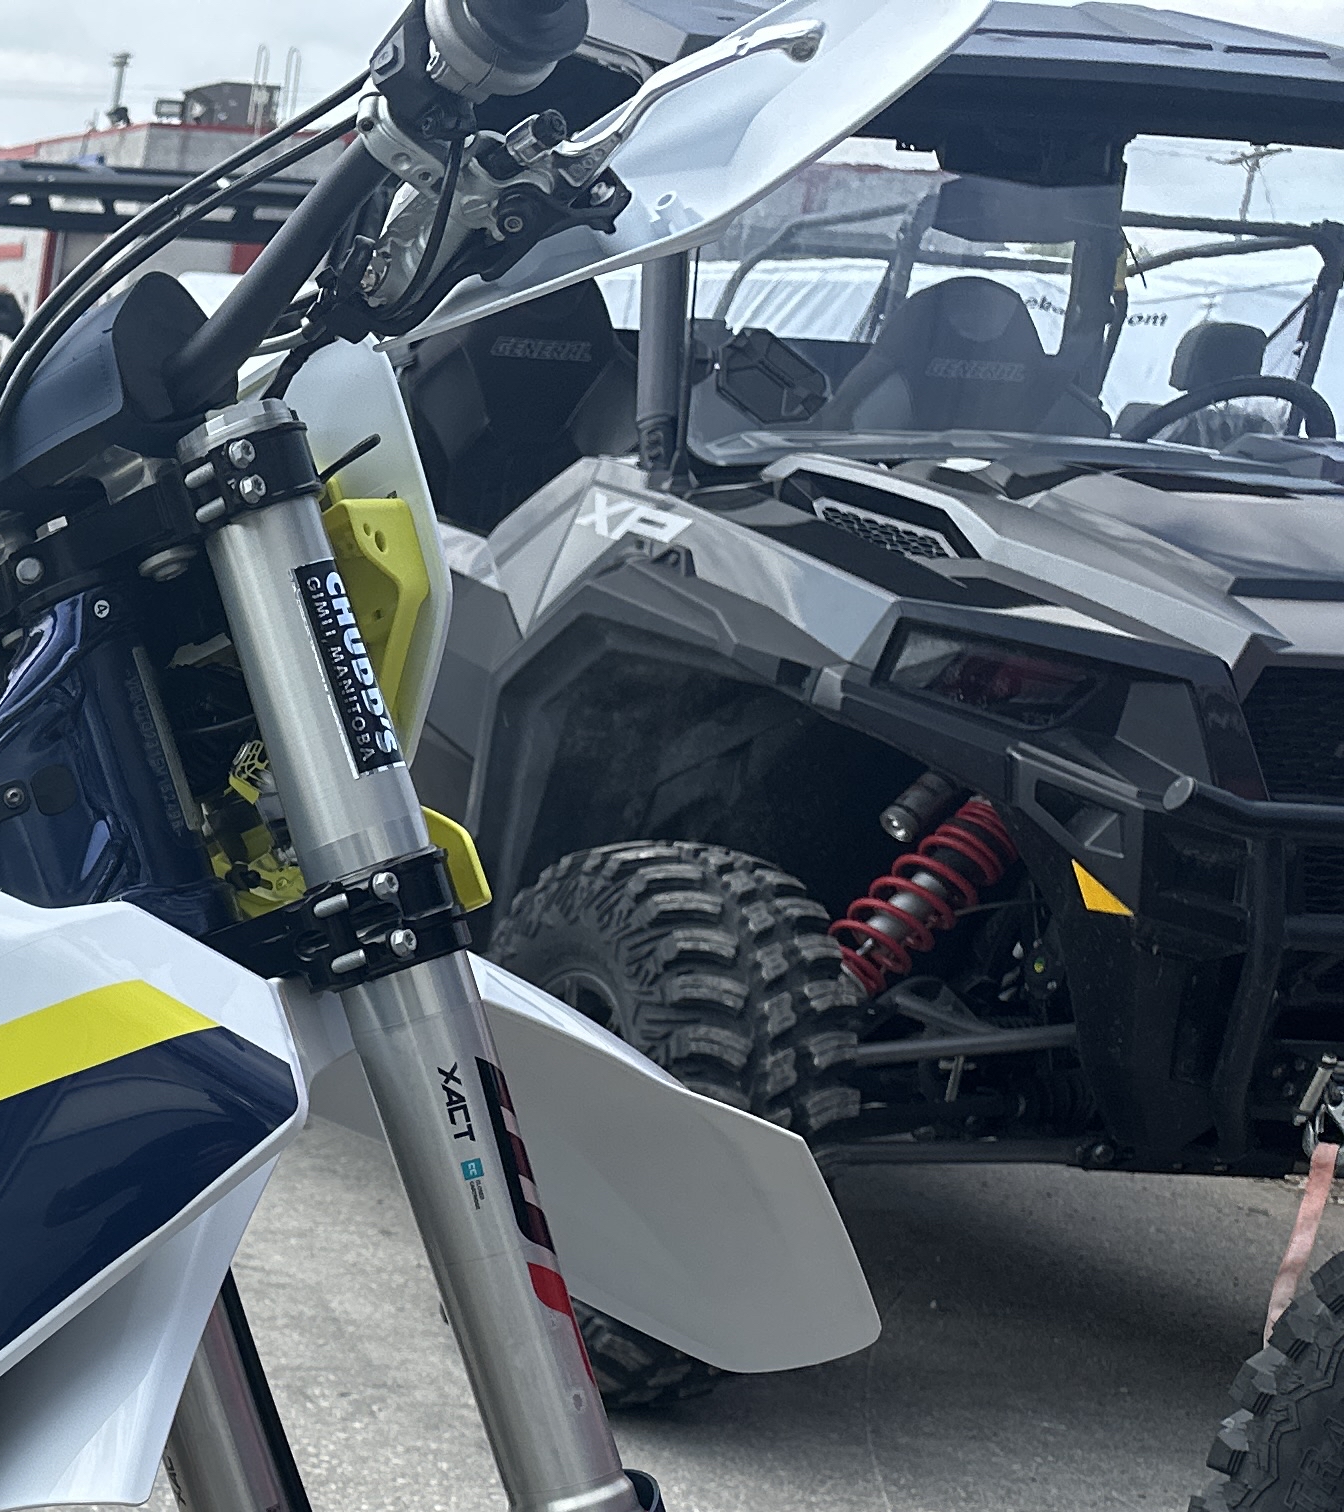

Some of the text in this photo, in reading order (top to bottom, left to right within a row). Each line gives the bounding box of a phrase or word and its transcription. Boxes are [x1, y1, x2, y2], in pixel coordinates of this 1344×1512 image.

[490, 336, 593, 362] GENERAL
[575, 492, 693, 544] XP
[325, 571, 398, 754] CHUDD'S
[330, 645, 376, 763] MANITOBA
[437, 1062, 476, 1142] XACT
